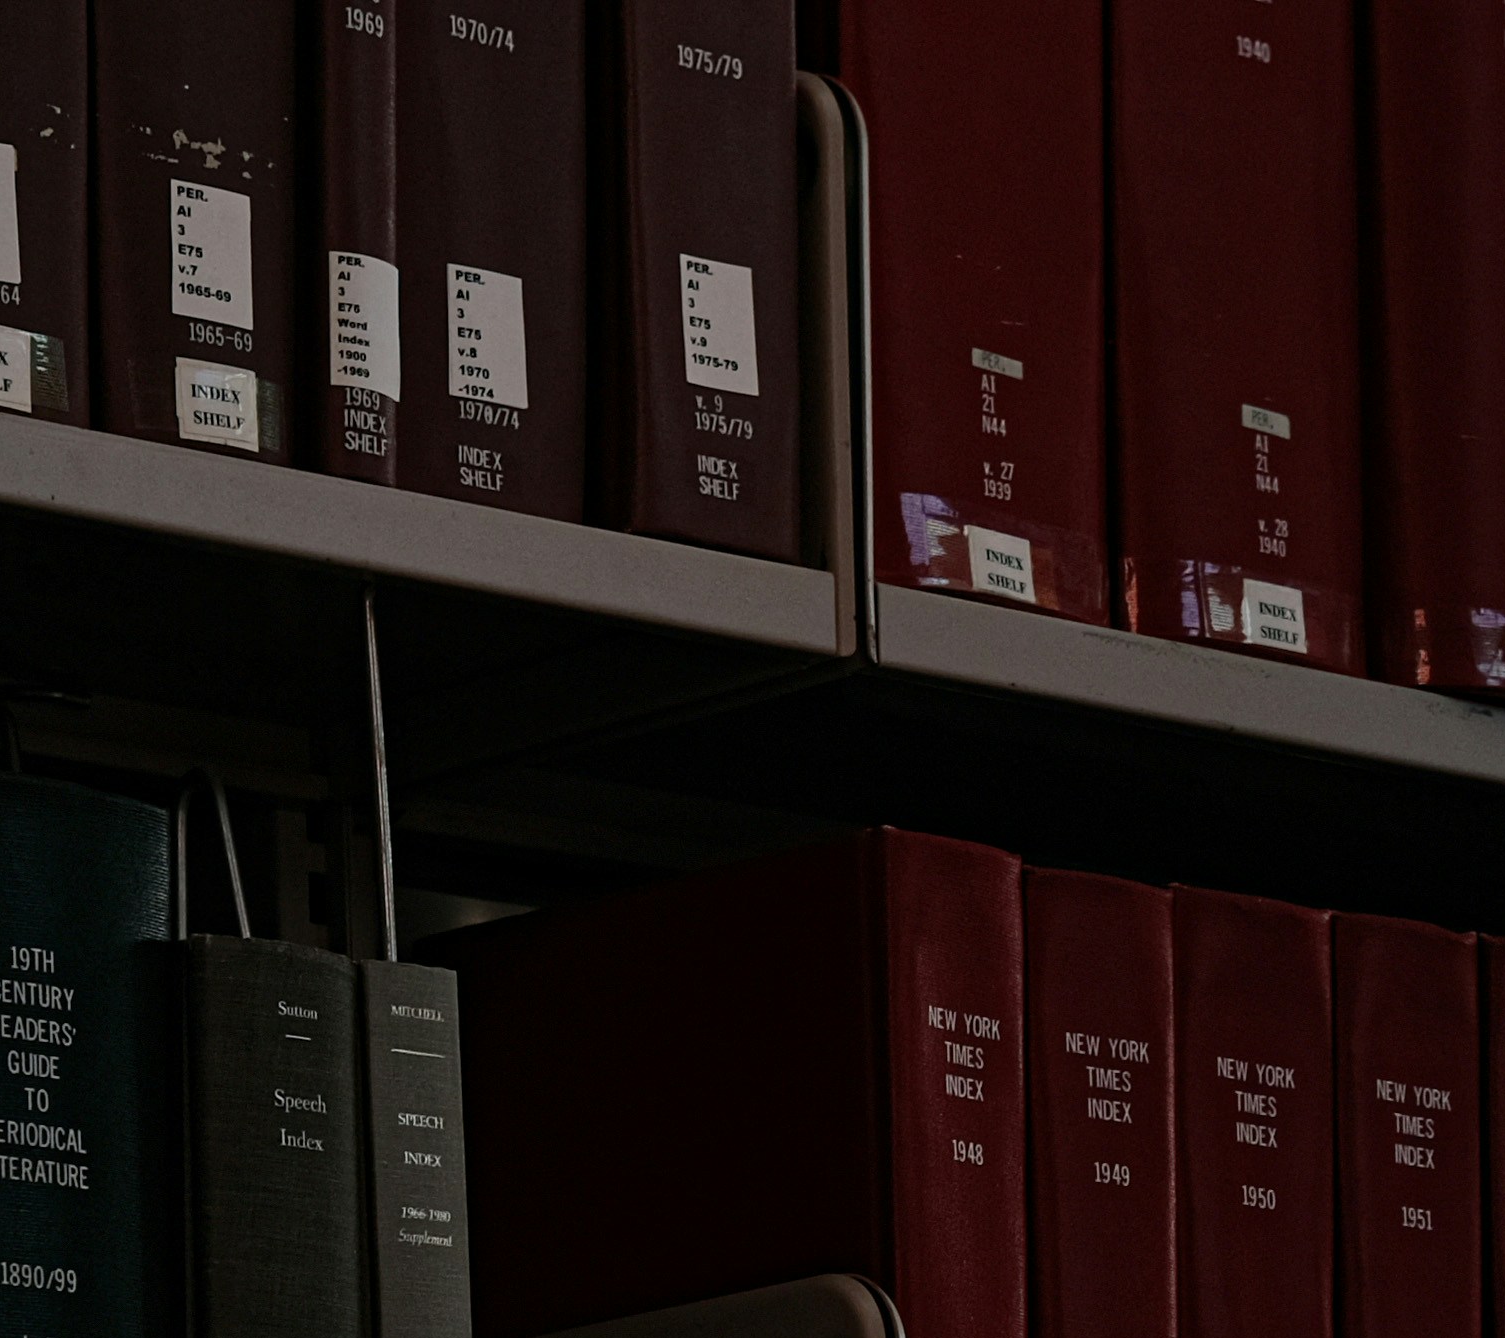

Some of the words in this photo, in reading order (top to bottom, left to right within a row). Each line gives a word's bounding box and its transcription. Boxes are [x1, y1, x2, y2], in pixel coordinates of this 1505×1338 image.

[450, 15, 514, 52] 1970/74
[678, 44, 743, 79] 1975/79
[983, 479, 1012, 502] 1939
[11, 946, 54, 973] 19TH
[278, 1001, 318, 1020] Sutton
[929, 1005, 957, 1031] NEW
[964, 1014, 1000, 1040] YORK
[7, 1050, 60, 1079] GUIDE
[944, 1041, 984, 1069] TIMES
[24, 1087, 49, 1112] TO
[946, 1074, 984, 1101] INDEX
[274, 1089, 326, 1113] Speech
[281, 1128, 323, 1151] Index
[952, 1139, 983, 1165] 1948
[404, 1151, 441, 1167] INDEX
[1094, 1162, 1130, 1186] 1949
[1402, 1206, 1433, 1230] 1951
[1, 1262, 77, 1293] 1890/99
